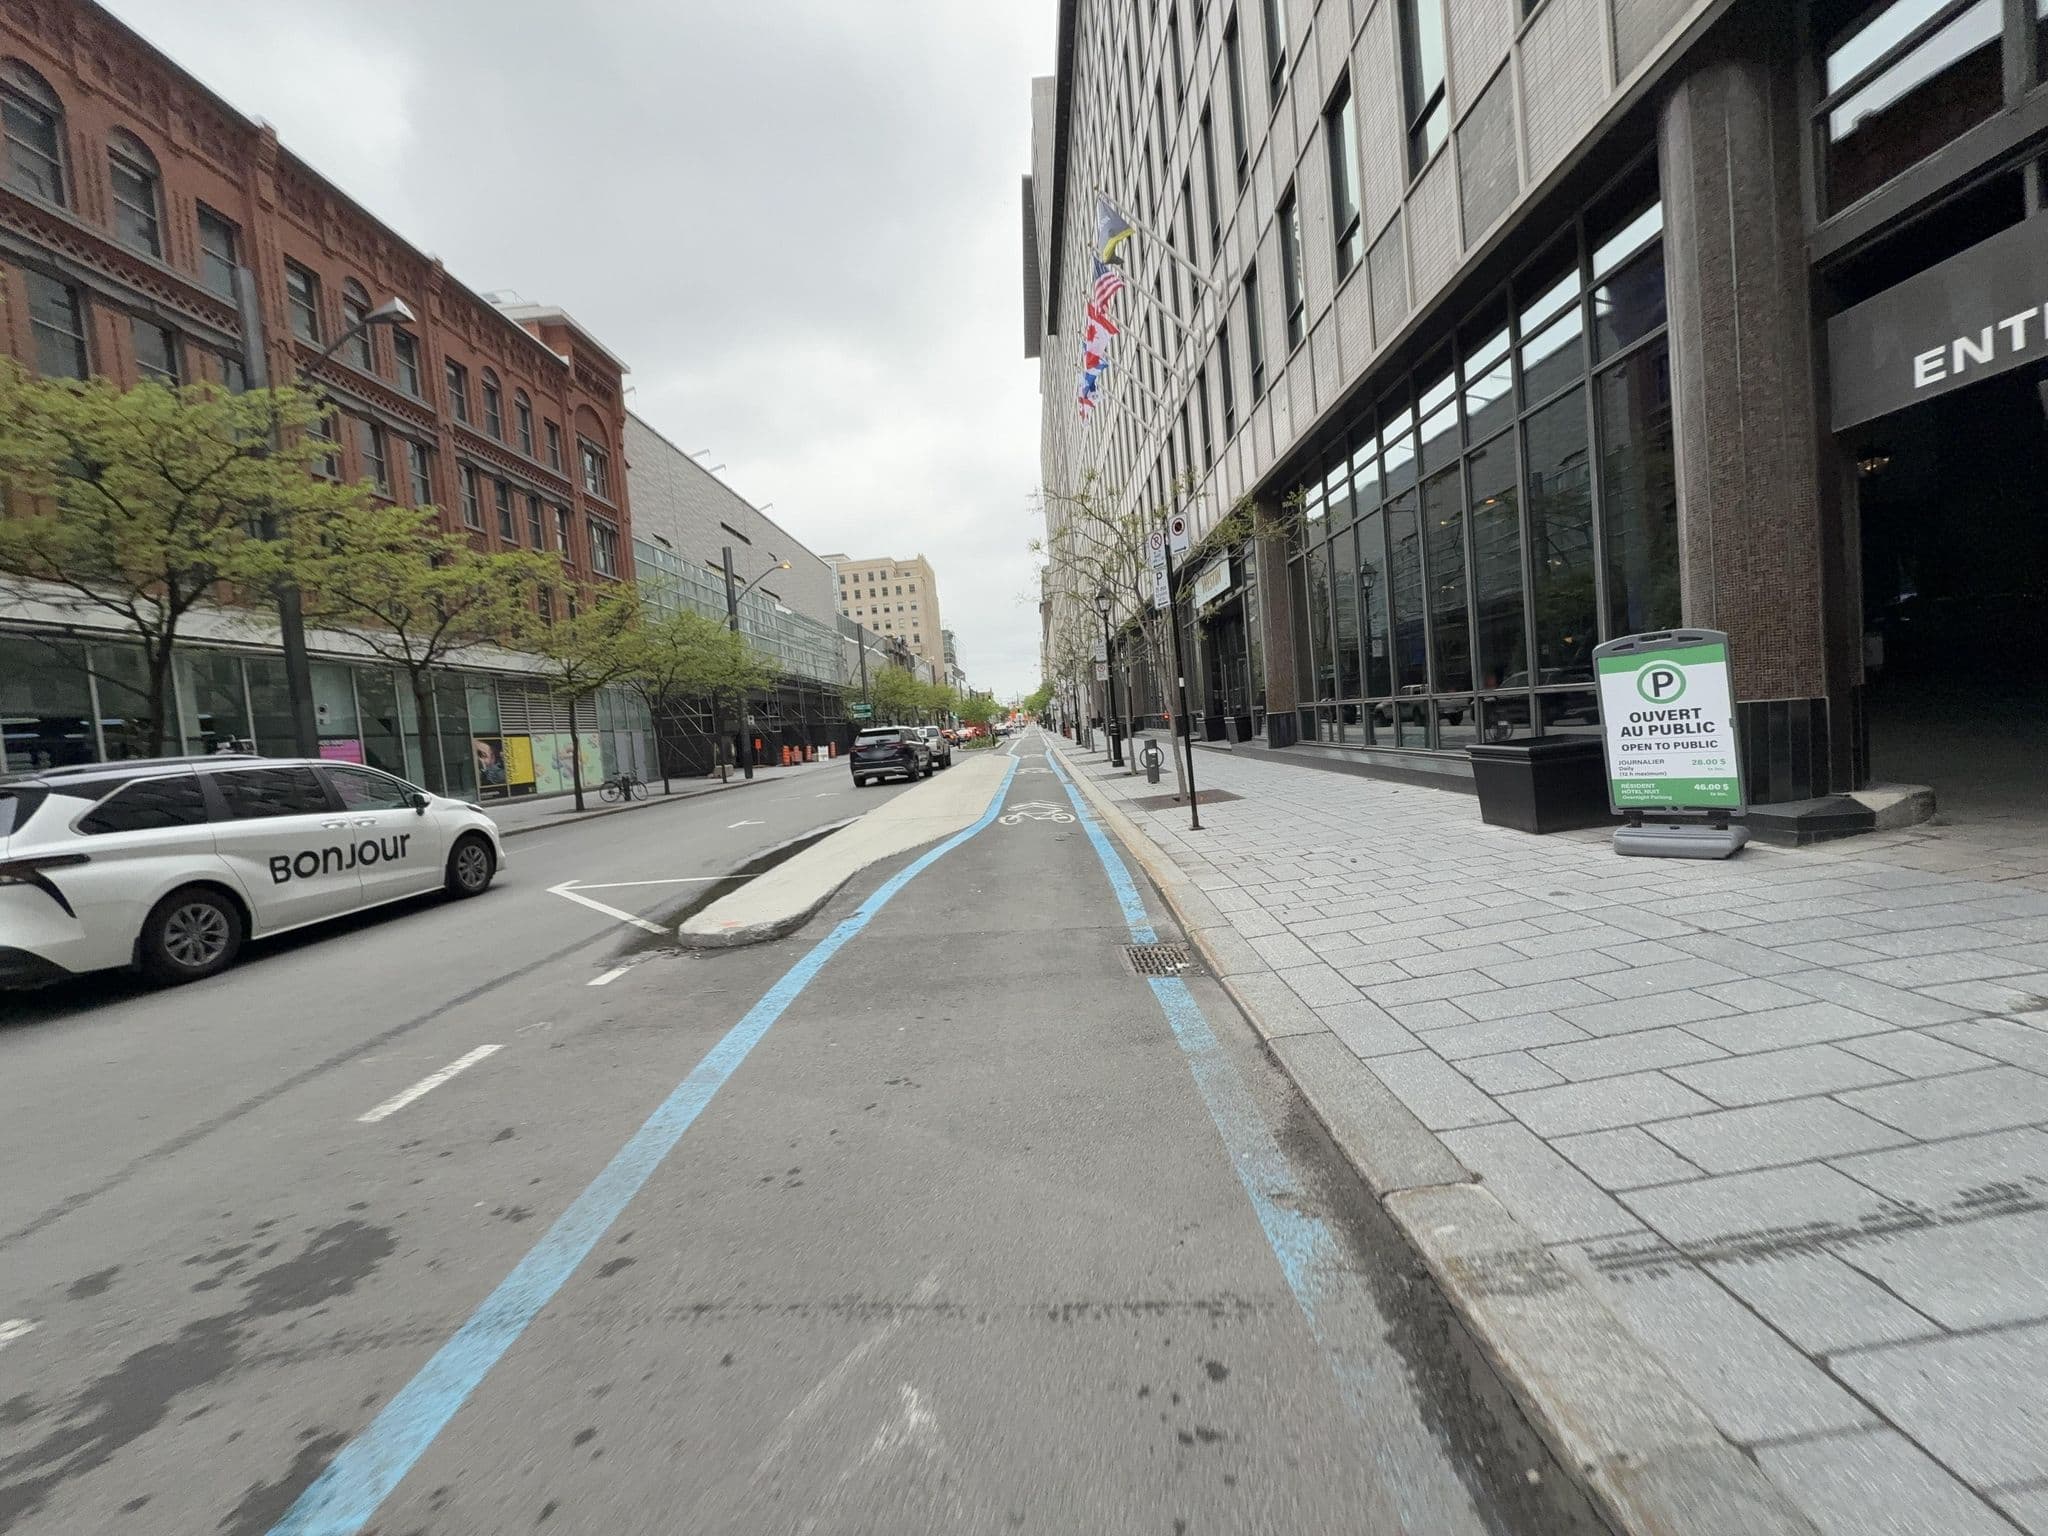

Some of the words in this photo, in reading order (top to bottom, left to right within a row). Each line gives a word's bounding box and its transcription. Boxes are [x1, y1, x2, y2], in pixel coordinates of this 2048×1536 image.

[1914, 302, 2048, 388] ENT
[1652, 672, 1674, 697] P
[1629, 707, 1702, 723] OUVERT
[1621, 726, 1643, 737] AU
[1648, 721, 1716, 736] PUBLIC
[1621, 743, 1652, 751] OPEN
[1655, 742, 1670, 750] TO
[1673, 740, 1718, 750] PUBLIC
